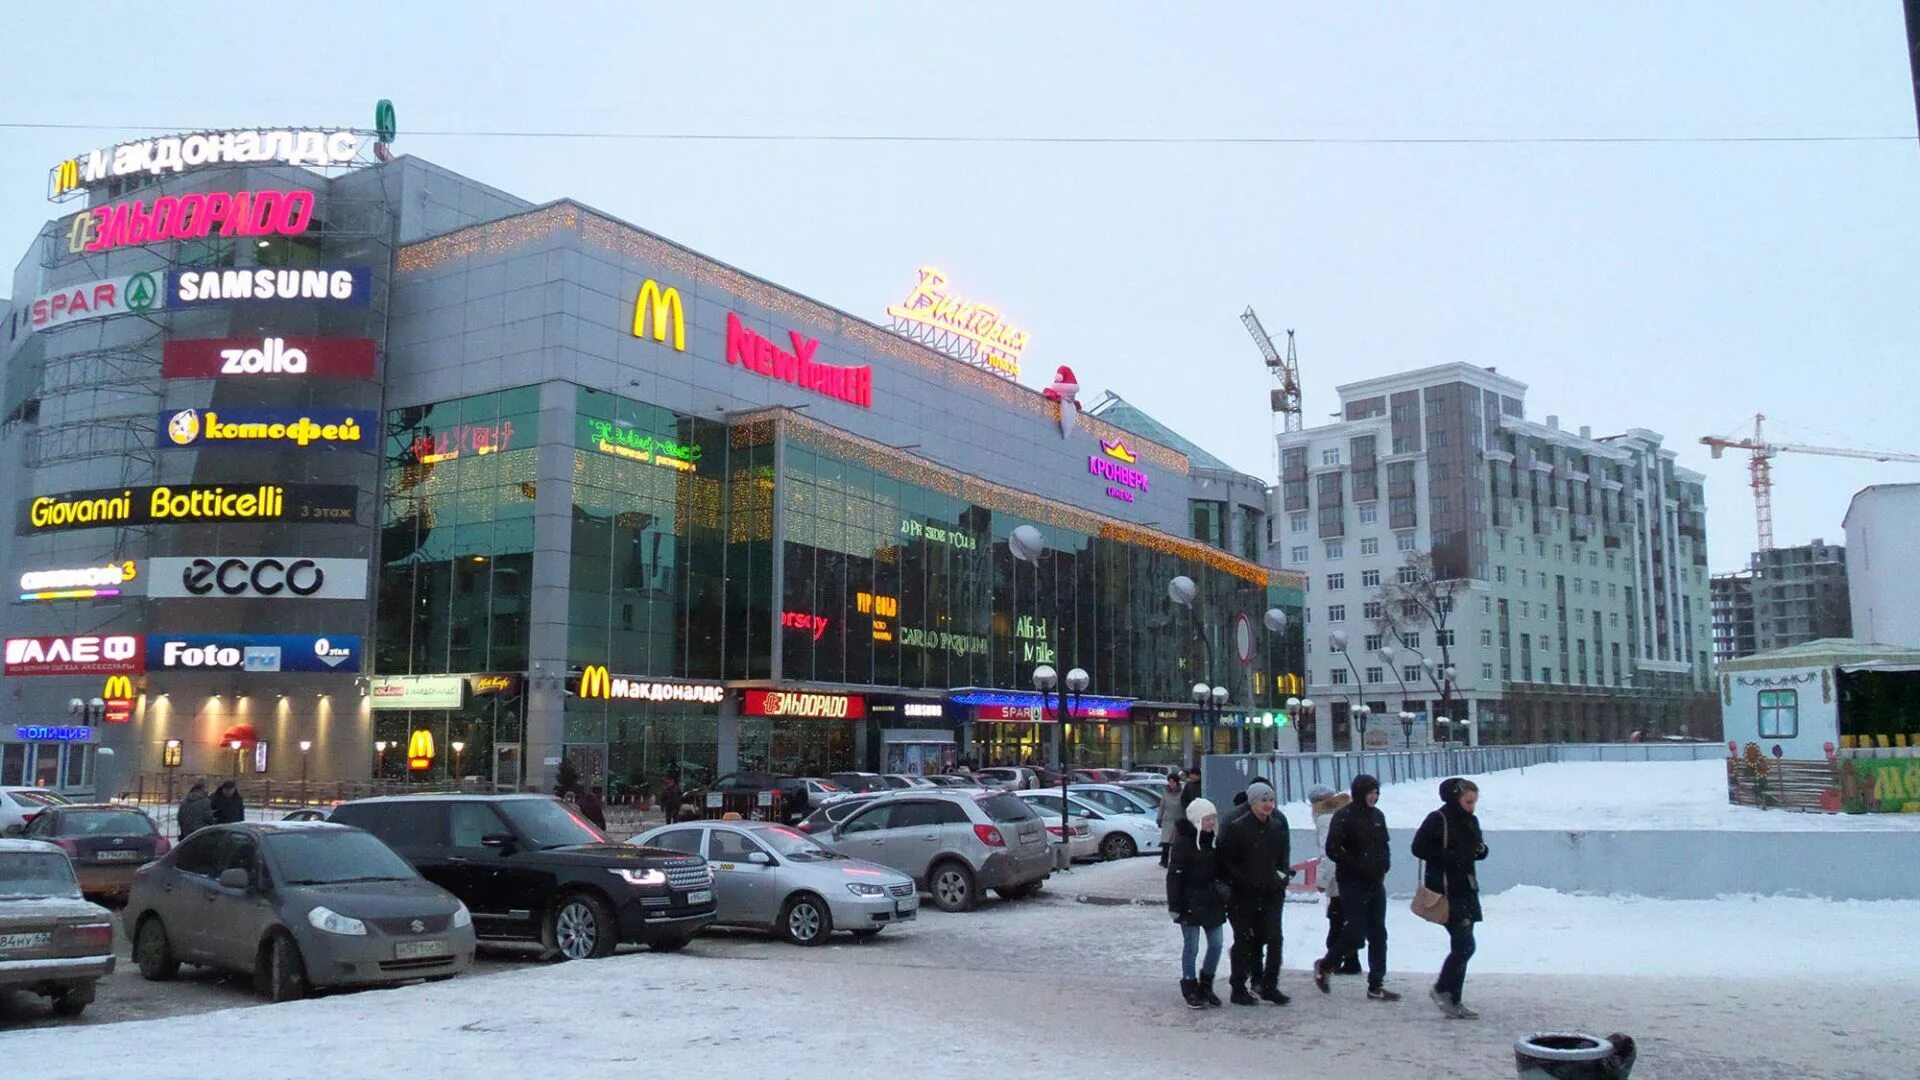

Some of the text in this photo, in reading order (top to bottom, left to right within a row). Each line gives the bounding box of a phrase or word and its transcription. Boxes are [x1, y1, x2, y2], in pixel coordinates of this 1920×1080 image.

[86, 131, 357, 182] Макдоналдс
[178, 269, 353, 301] SAMSUNG
[32, 283, 116, 326] SPAR
[220, 337, 308, 374] zolla
[205, 411, 361, 446] котофей
[1088, 455, 1148, 492] КРОНВЕРК
[31, 486, 284, 528] Giovanni Botticelli
[182, 558, 324, 596] ecco
[611, 678, 725, 703] Макдоналдс
[1001, 705, 1030, 718] SPAR
